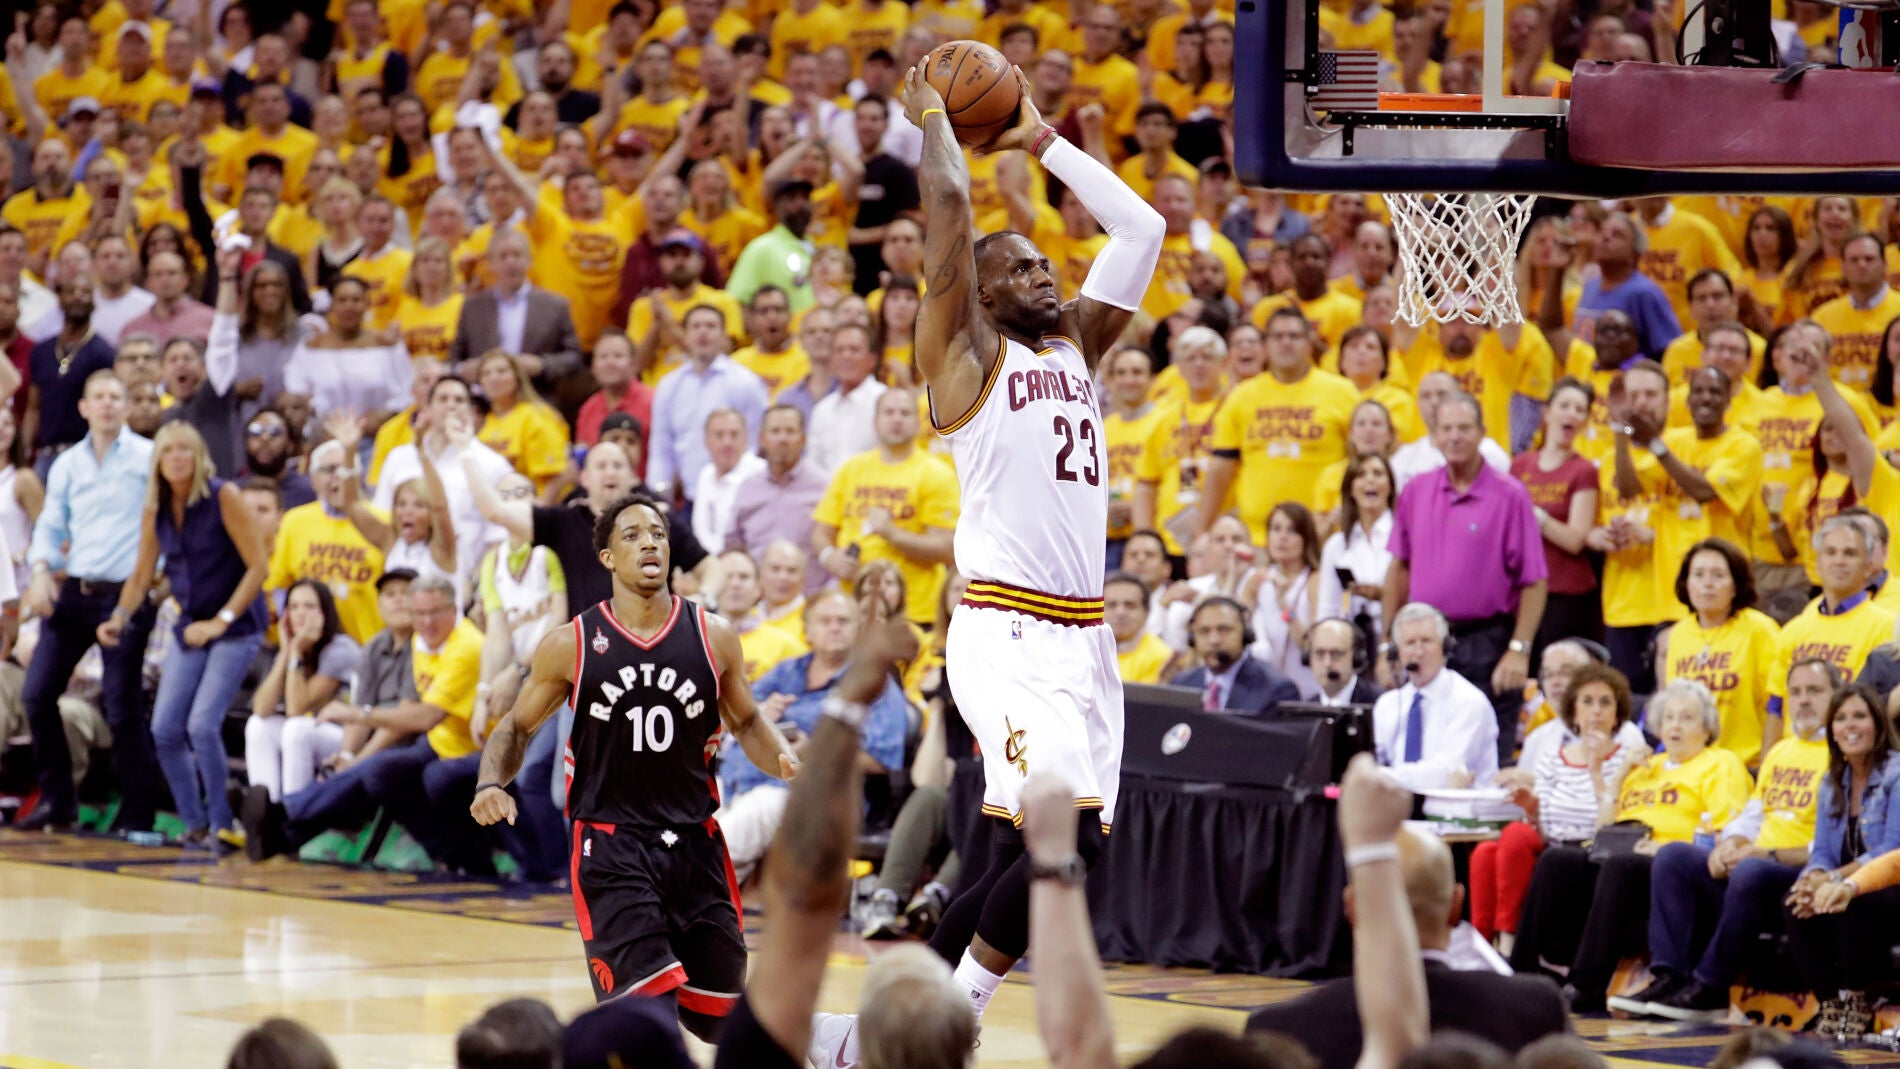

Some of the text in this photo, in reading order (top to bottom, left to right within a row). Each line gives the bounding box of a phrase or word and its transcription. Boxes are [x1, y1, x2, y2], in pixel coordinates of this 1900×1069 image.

[1053, 415, 1100, 487] 23
[308, 542, 367, 562] WINE
[589, 663, 705, 722] RAPTORS
[625, 705, 674, 753] 10
[1772, 765, 1817, 787] WINE
